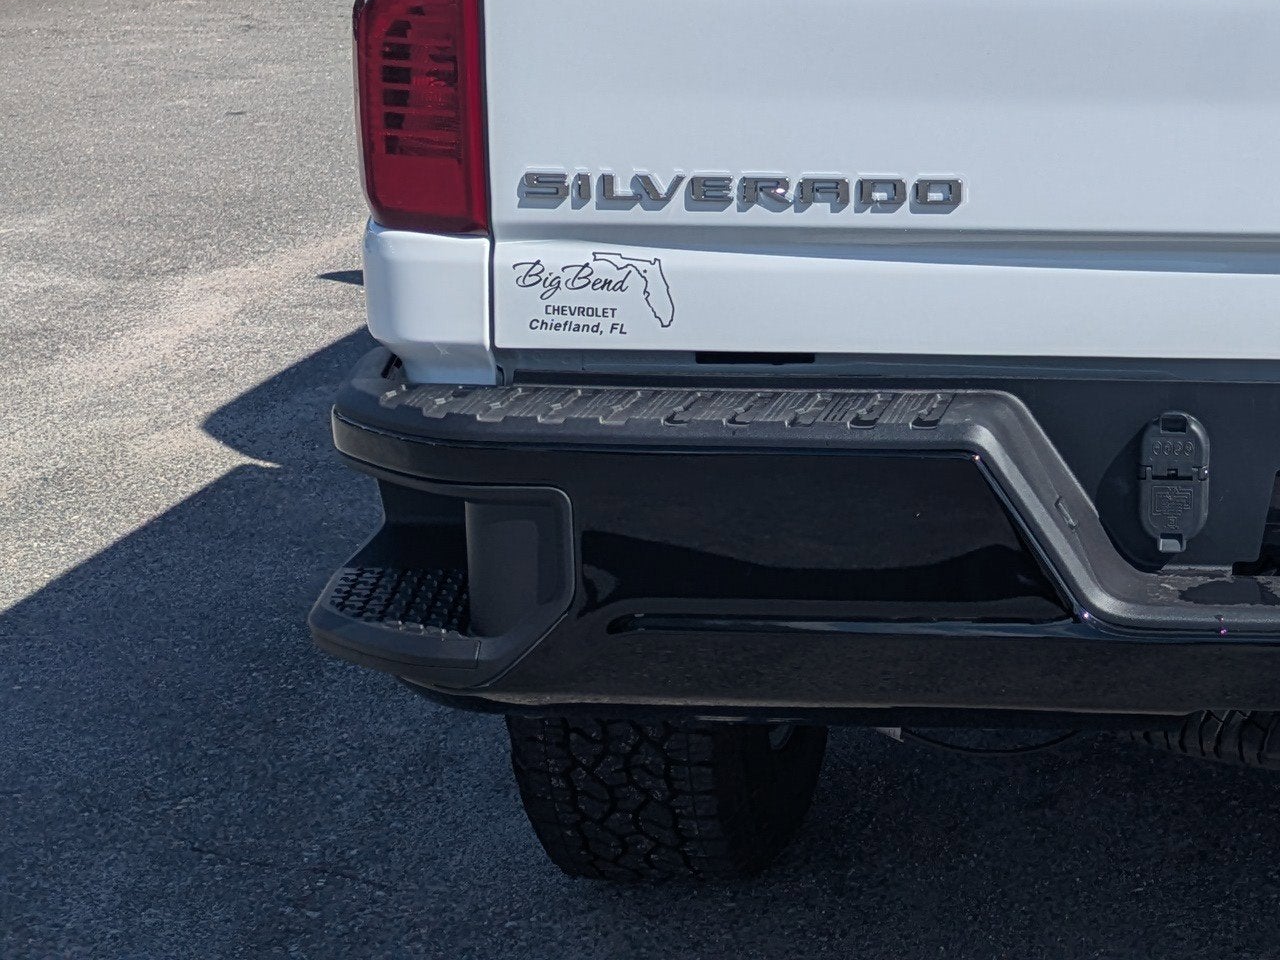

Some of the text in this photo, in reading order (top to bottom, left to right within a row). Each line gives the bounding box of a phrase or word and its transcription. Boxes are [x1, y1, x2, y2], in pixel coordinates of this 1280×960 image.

[519, 171, 965, 210] SILVERADO
[512, 259, 633, 300] Big Bend
[544, 304, 618, 319] CHEVROLET
[529, 318, 628, 336] Chiefland, FL
